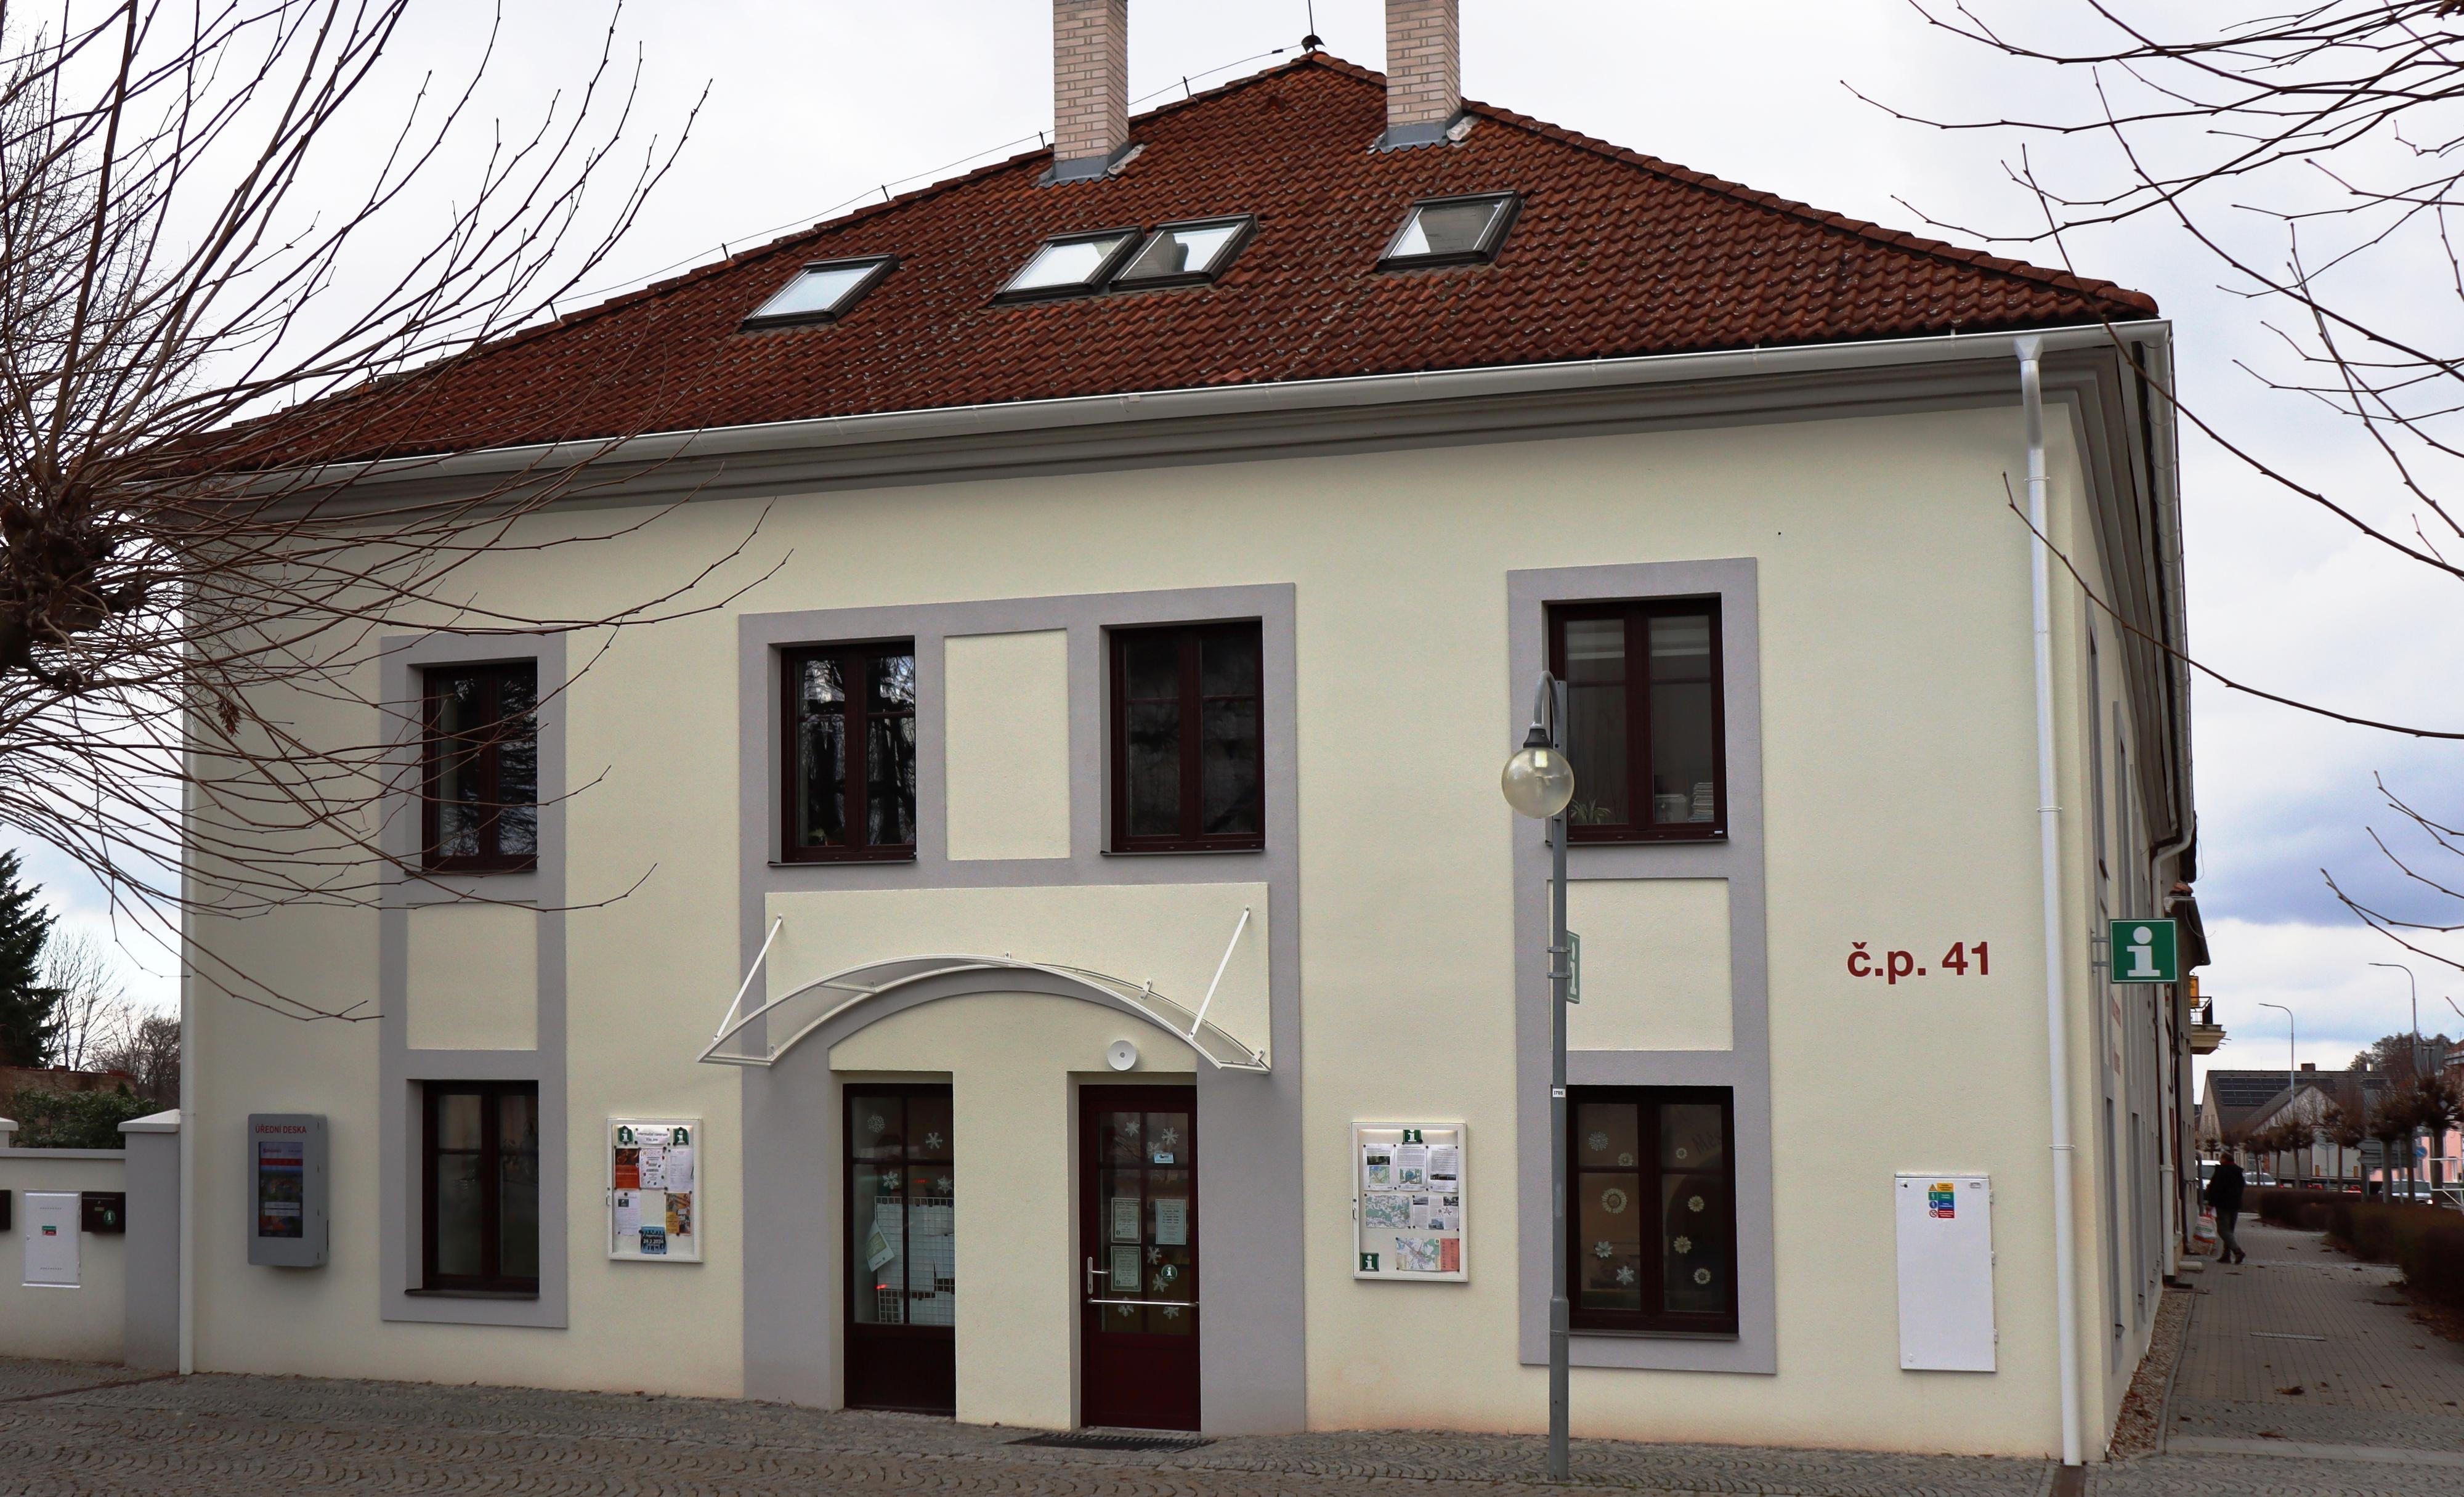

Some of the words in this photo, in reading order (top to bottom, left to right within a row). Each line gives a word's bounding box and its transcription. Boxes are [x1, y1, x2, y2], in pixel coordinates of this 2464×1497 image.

[1847, 941, 1926, 984] č.p.
[1942, 941, 1988, 975] 41
[256, 1124, 281, 1134] ÚŘEDNÍ
[283, 1126, 307, 1134] DESKA
